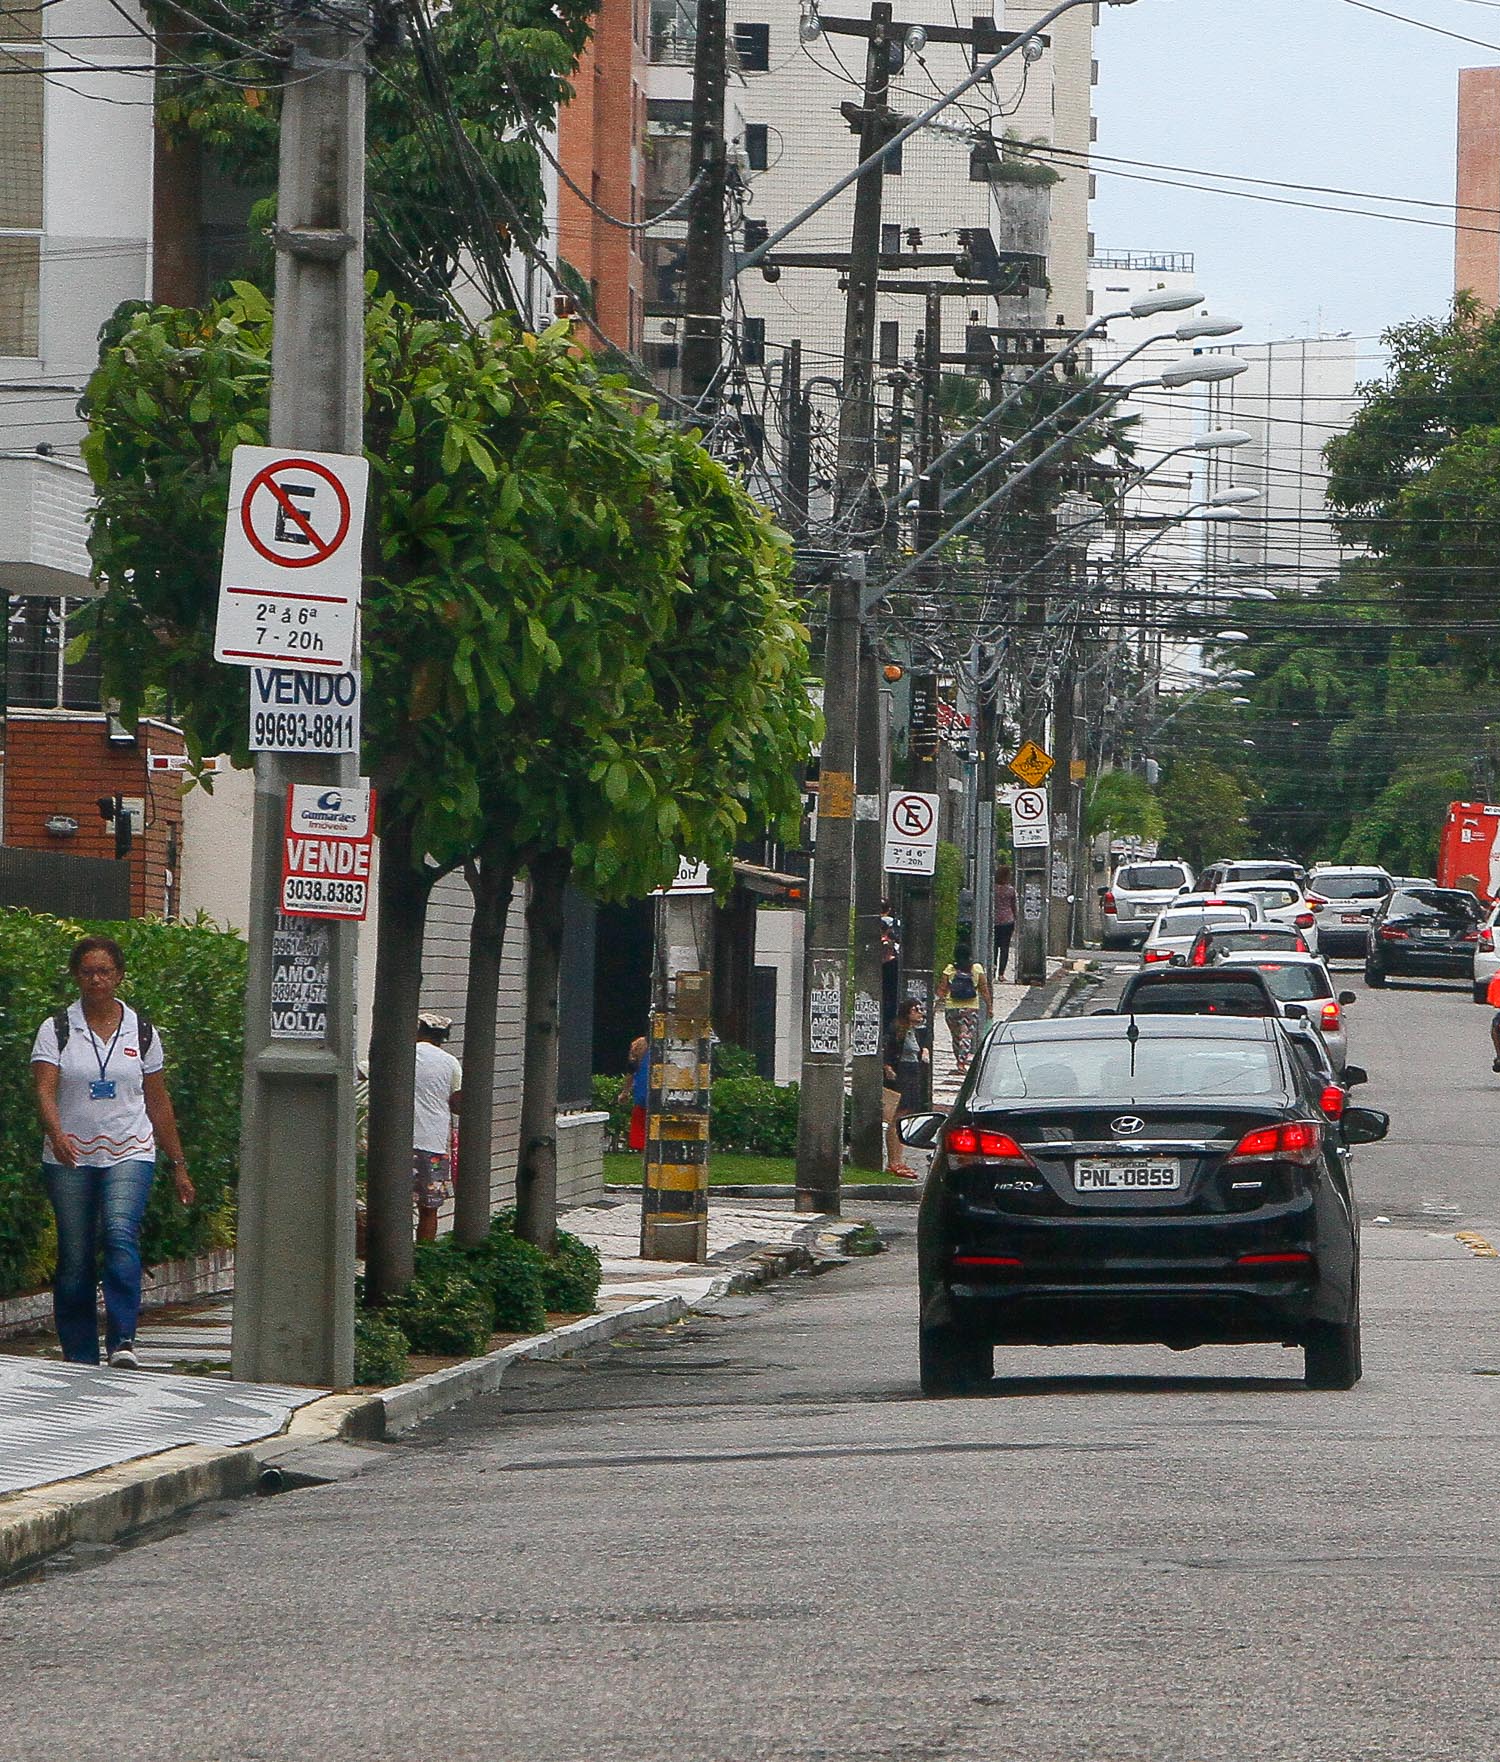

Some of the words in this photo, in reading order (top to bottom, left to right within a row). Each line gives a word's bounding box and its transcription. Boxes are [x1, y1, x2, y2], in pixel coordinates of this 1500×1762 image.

[256, 627, 267, 646] 7
[287, 630, 324, 651] 20h
[254, 667, 357, 707] VENDO
[255, 712, 353, 748] 99693-8811
[286, 838, 370, 877] VENDE
[287, 880, 363, 904] 3038.8383
[272, 1012, 327, 1031] VOLTA
